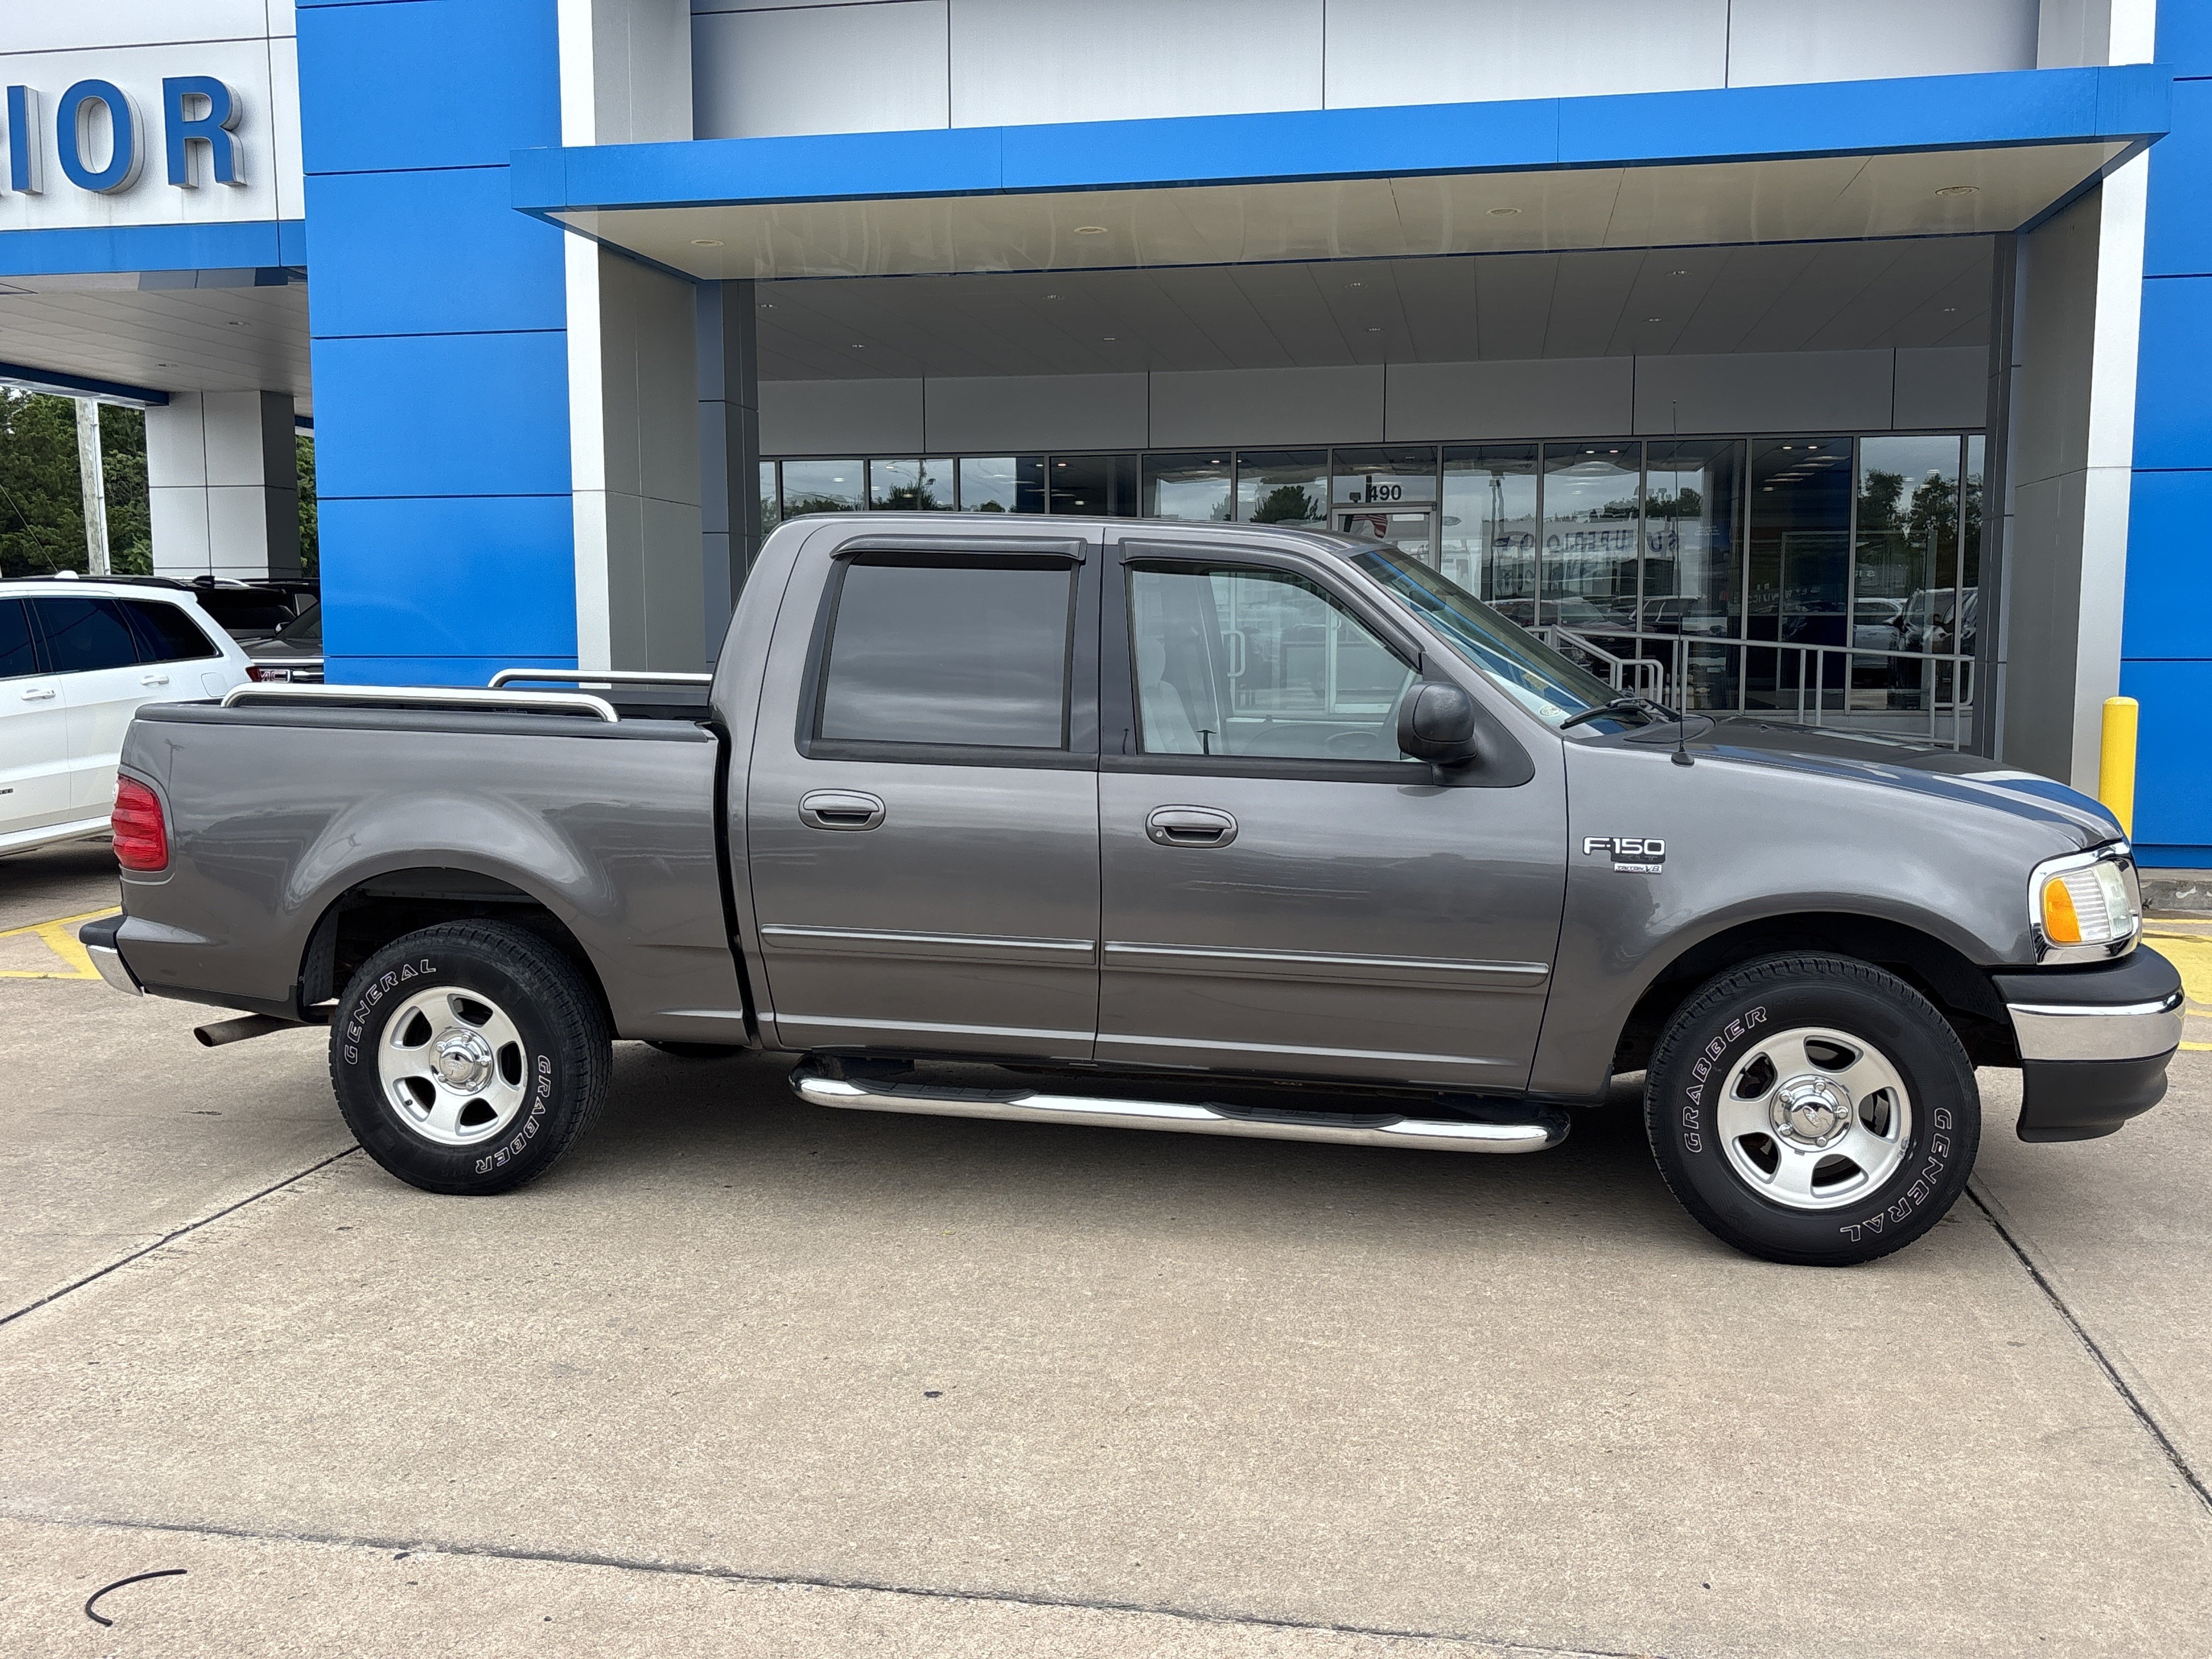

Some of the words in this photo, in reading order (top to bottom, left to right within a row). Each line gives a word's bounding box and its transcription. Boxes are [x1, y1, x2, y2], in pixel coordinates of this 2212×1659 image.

[1370, 485, 1402, 500] 490
[260, 670, 286, 681] MC
[1583, 837, 1666, 855] F-150
[343, 959, 437, 1065] GENERAL
[475, 1055, 552, 1174] GRABBER
[1683, 1006, 1767, 1153] GRABBER
[1840, 1107, 1953, 1242] GENERAL
